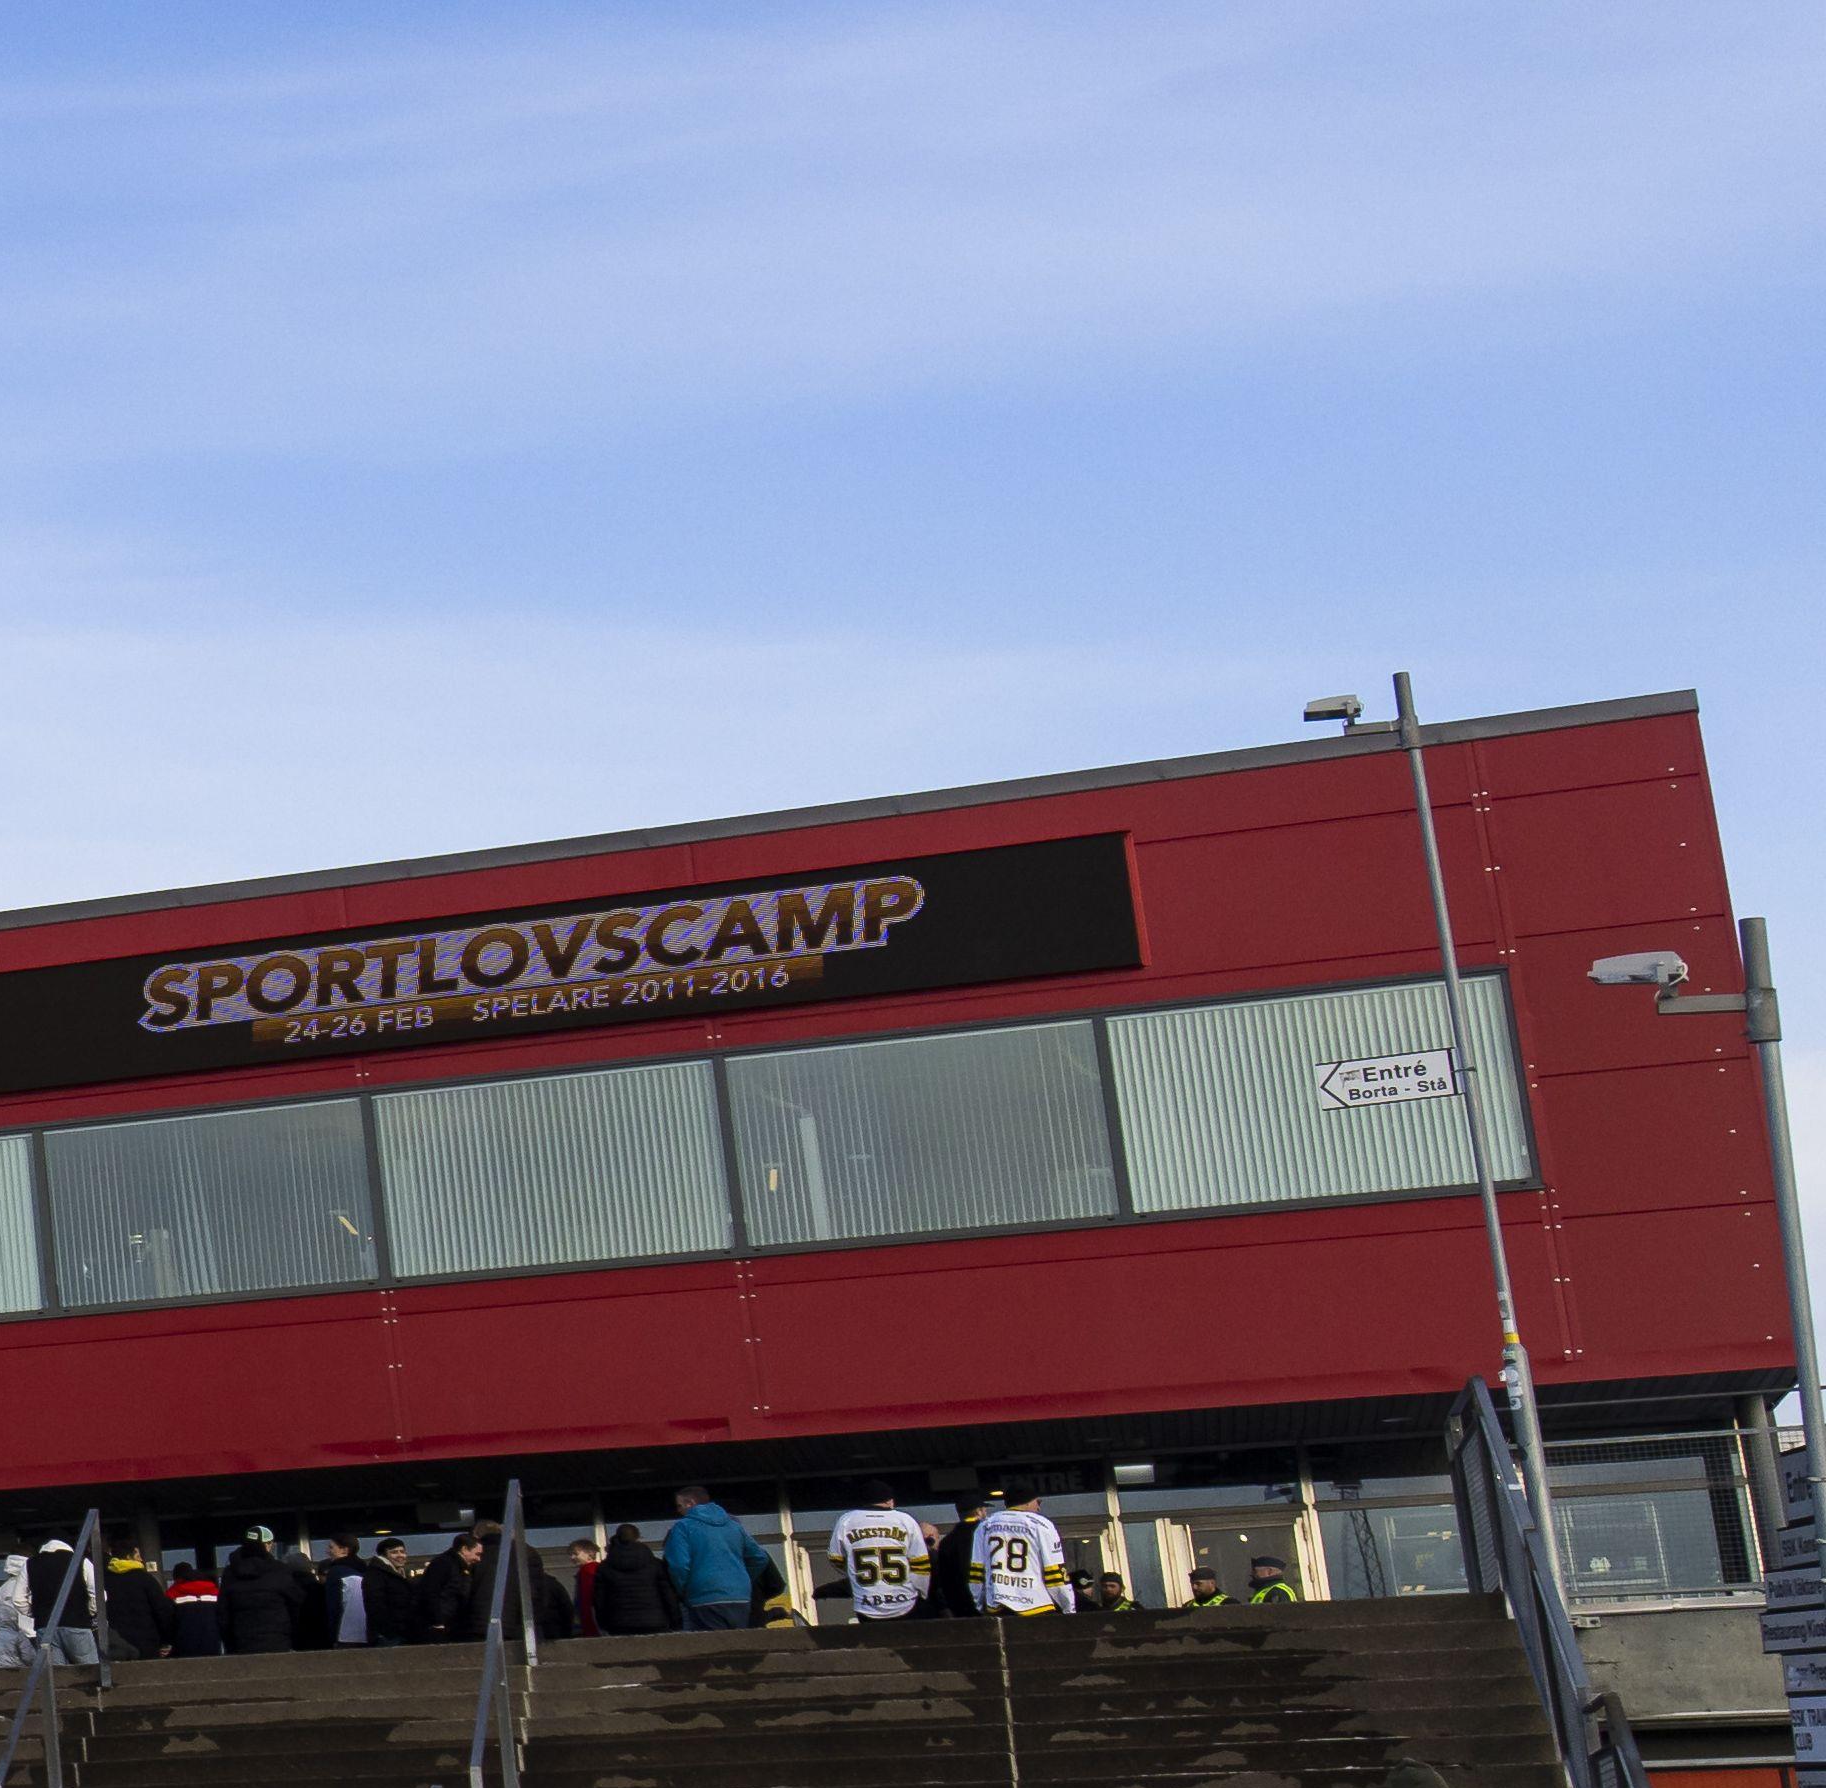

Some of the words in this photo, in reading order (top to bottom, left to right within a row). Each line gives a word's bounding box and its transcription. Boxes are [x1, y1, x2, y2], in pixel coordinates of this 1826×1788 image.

[144, 879, 920, 1030] SPORTLOVSCAMP
[284, 1014, 367, 1045] 24-26
[377, 1006, 434, 1034] FEB
[472, 984, 611, 1022] SPELARE
[622, 964, 790, 1006] 2011-2016
[1349, 1086, 1399, 1101] Borta
[1417, 1077, 1448, 1093] Stå
[1363, 1060, 1428, 1083] Entré
[853, 1546, 908, 1586] 55
[988, 1536, 1029, 1573] 28
